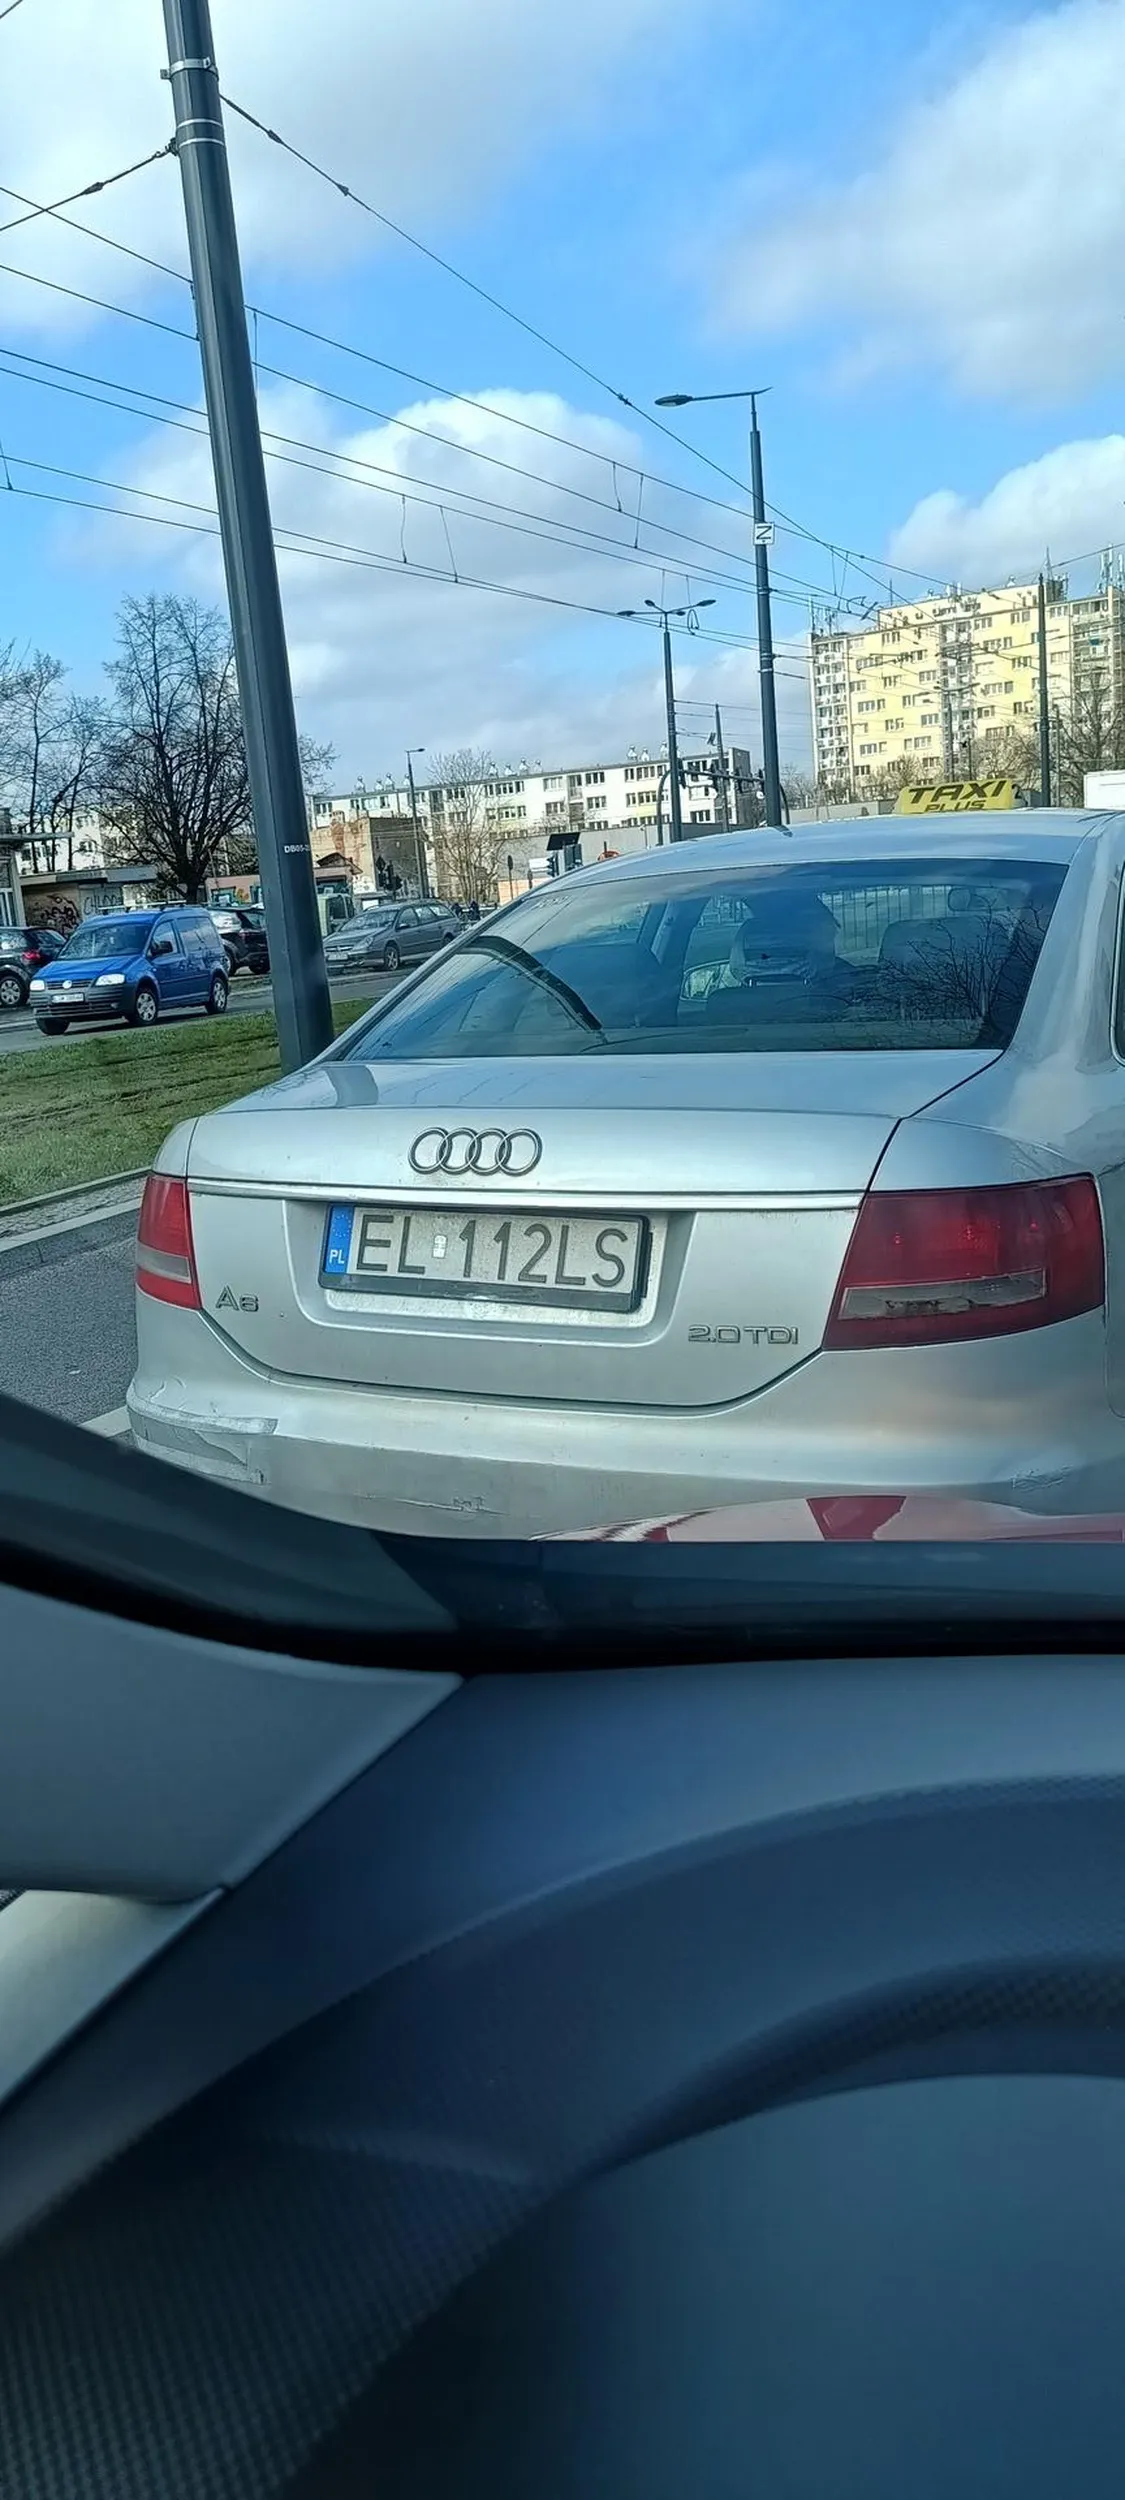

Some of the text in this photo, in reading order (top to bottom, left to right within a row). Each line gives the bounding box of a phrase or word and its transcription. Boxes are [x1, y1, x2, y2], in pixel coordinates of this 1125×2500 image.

[908, 780, 1006, 804] TAXI
[924, 800, 986, 812] PLUS
[328, 1250, 345, 1265] PL
[356, 1214, 628, 1288] EL 112LS
[215, 1285, 259, 1312] A6
[688, 1325, 798, 1344] 2.0 TDI
